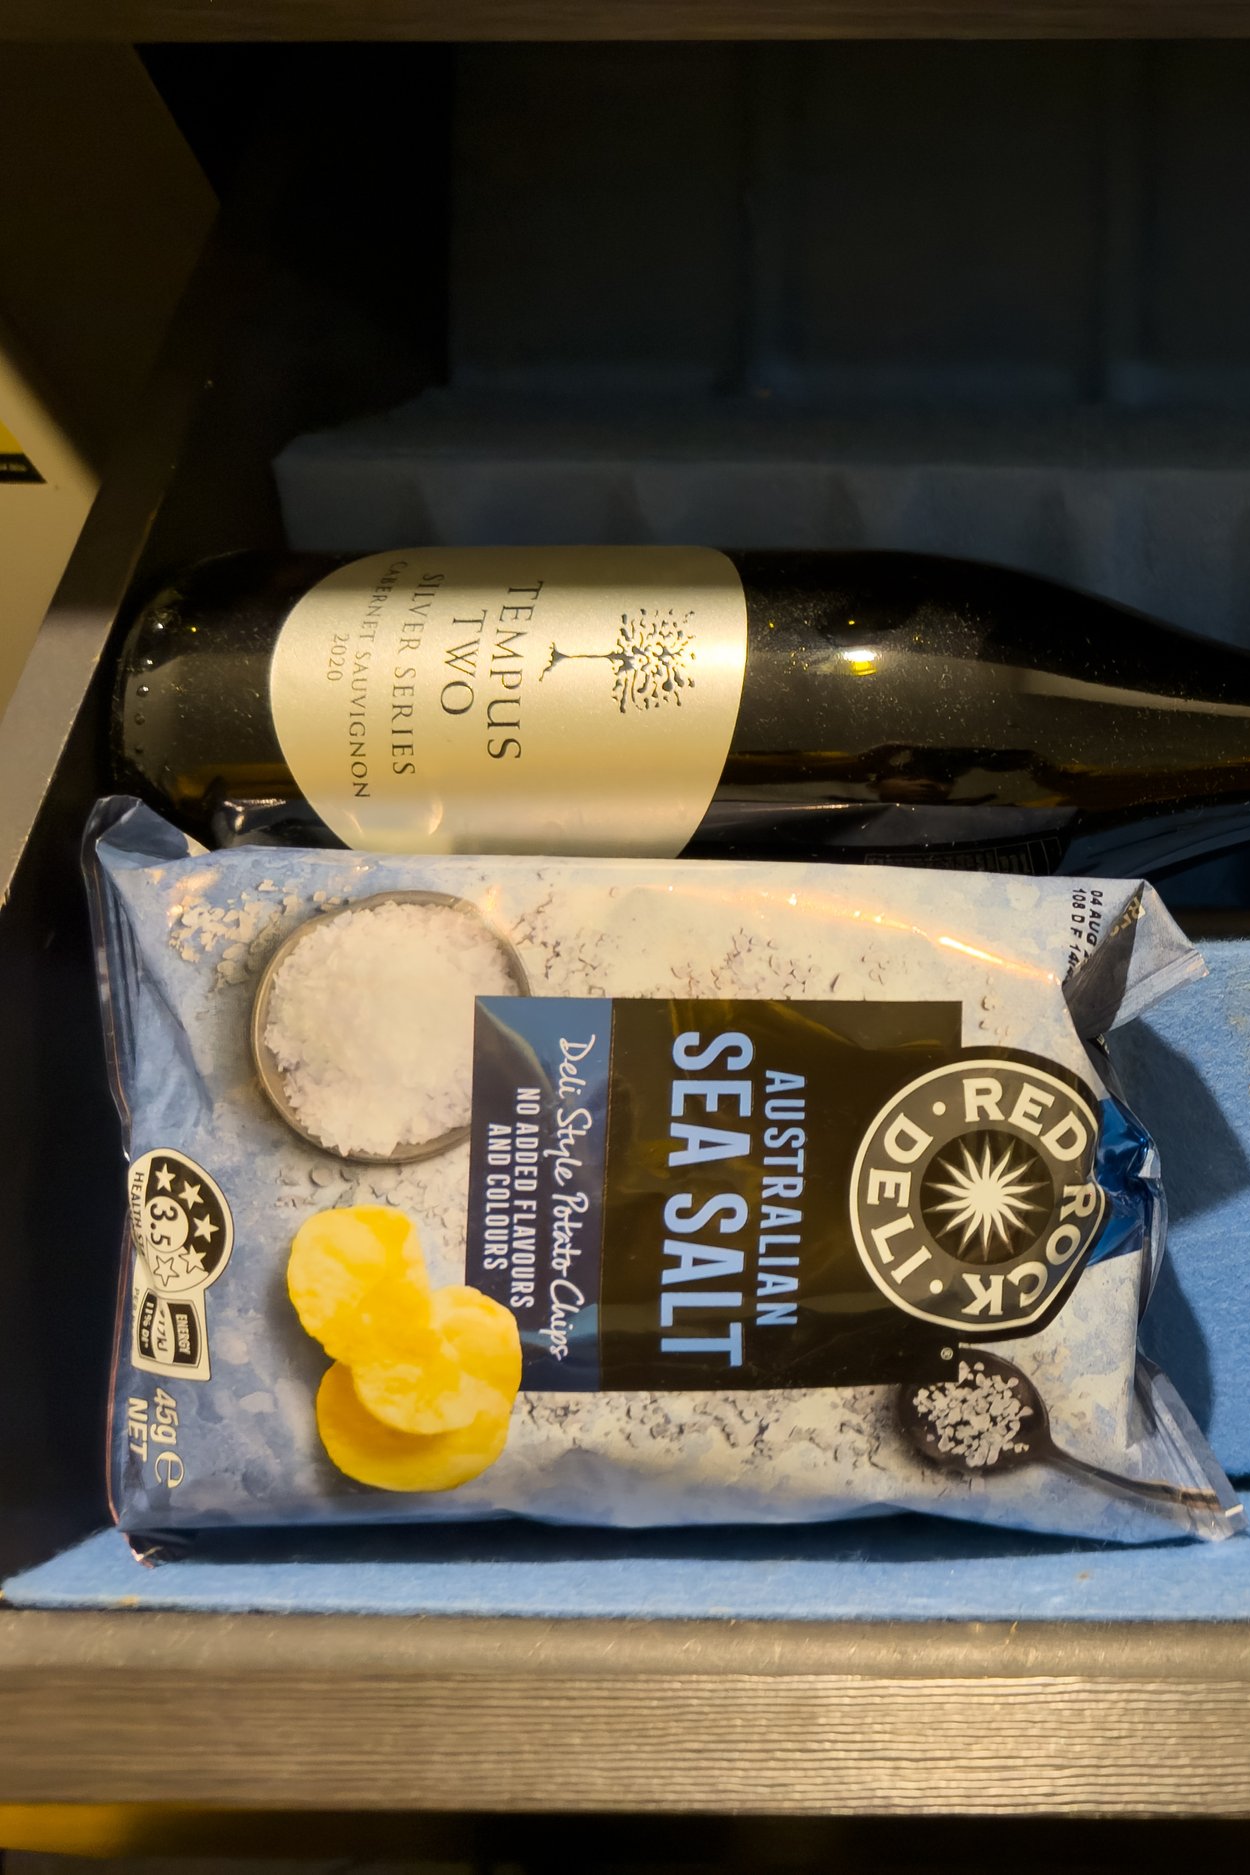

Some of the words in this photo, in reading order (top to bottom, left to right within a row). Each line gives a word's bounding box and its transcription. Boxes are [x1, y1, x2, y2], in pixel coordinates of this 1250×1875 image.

[359, 561, 408, 644] CABERNET
[398, 574, 445, 654] SILVER
[326, 634, 350, 681] 2020
[440, 609, 488, 716] TWO
[486, 580, 544, 760] TEMPUS
[349, 652, 371, 798] SAUVIGNON
[391, 667, 416, 776] SERIES
[1070, 927, 1082, 939] F
[1072, 888, 1087, 910] 108
[1072, 914, 1086, 924] D
[1086, 908, 1102, 947] AUG
[1090, 890, 1103, 906] 04
[515, 1088, 541, 1116] NO
[558, 1034, 596, 1098] Deli
[668, 1031, 754, 1168] SEA
[486, 1124, 512, 1166] AND
[514, 1122, 540, 1192] ADDED
[543, 1106, 592, 1186] Style
[962, 1077, 1088, 1162] RED
[130, 1172, 145, 1228] HEALTH
[150, 1203, 178, 1246] 3.5
[482, 1174, 510, 1270] COLOURS
[550, 1192, 589, 1278] Potato
[755, 1070, 806, 1326] AUSTRALIAN
[866, 1112, 934, 1285] DELI
[510, 1200, 538, 1308] FLAVOURS
[660, 1192, 748, 1367] SALT
[960, 1182, 1098, 1316] ROCK
[142, 1302, 154, 1327] 11%
[175, 1314, 191, 1355] ENERGY
[538, 1278, 585, 1362] Chips
[127, 1396, 148, 1463] NET
[150, 1387, 179, 1446] 45g
